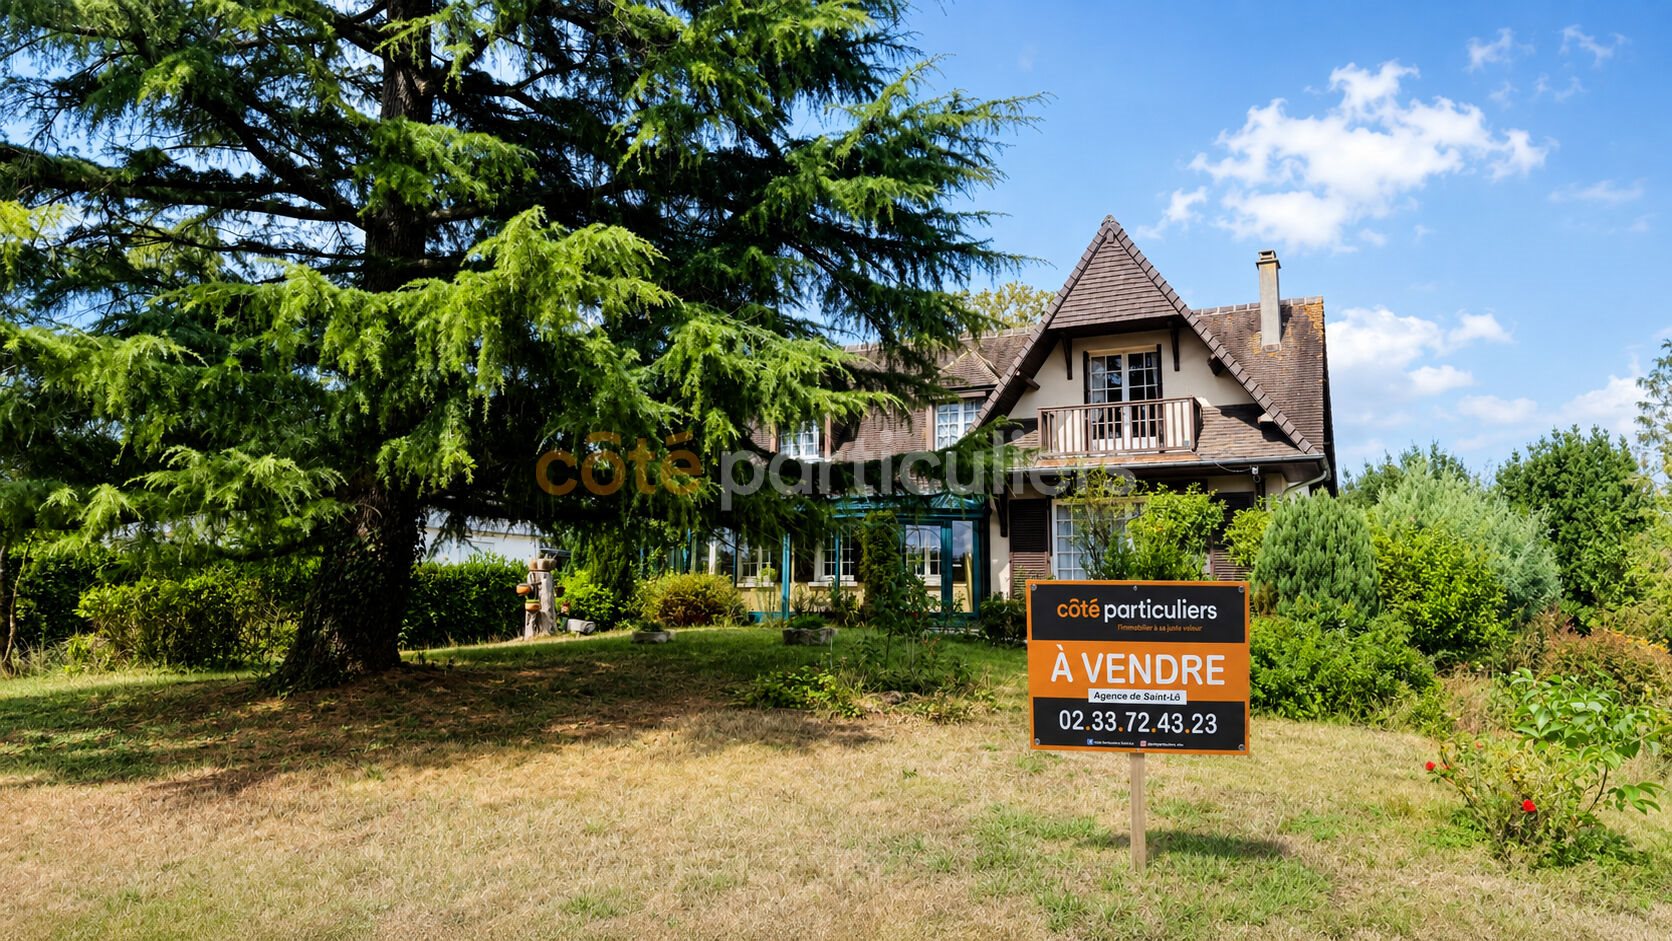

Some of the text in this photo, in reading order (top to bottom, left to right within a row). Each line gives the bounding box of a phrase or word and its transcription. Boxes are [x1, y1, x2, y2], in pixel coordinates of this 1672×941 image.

[1056, 598, 1218, 623] côté particuliers
[1050, 643, 1226, 686] À VENDRE
[1093, 691, 1181, 702] Agence de Saint-Lô
[1058, 709, 1218, 735] 02.33.72.43.23
